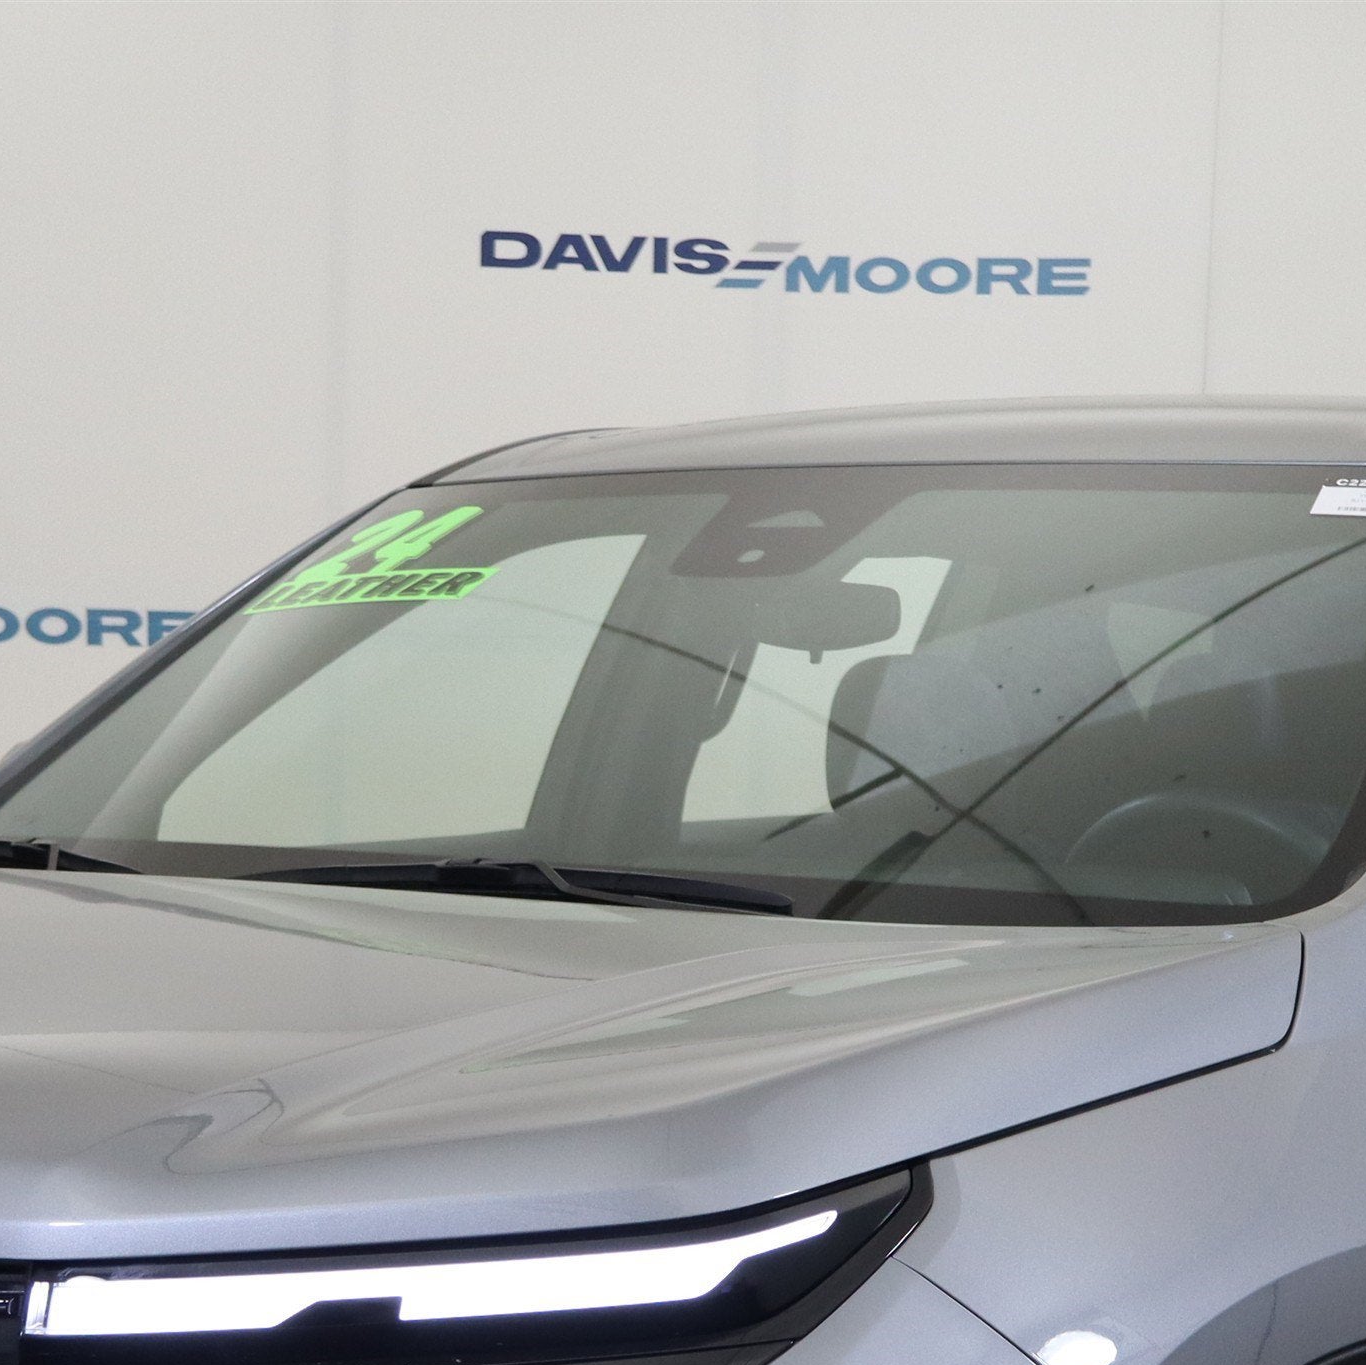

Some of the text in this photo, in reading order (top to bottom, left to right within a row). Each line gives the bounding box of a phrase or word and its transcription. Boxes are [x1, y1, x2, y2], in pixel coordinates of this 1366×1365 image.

[480, 230, 1092, 296] DAVIS MOORE
[248, 570, 486, 612] LEATHER
